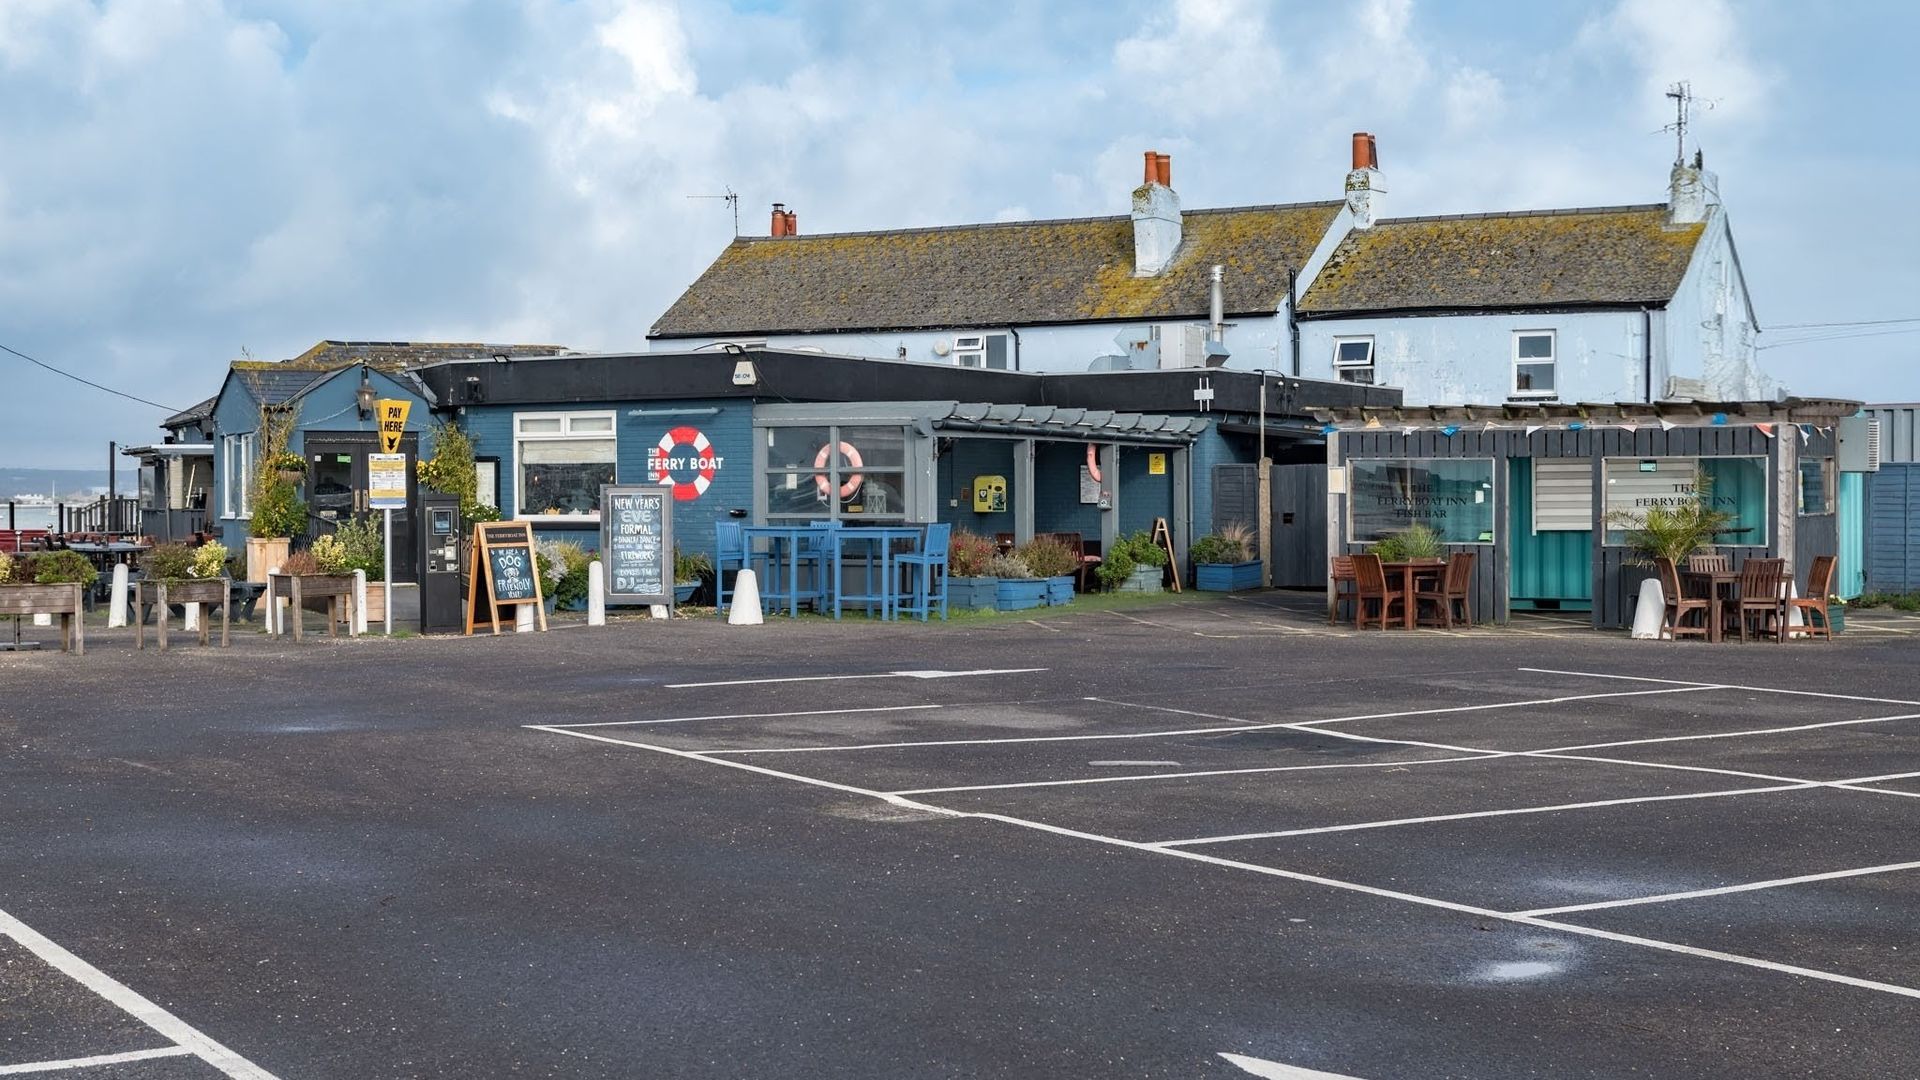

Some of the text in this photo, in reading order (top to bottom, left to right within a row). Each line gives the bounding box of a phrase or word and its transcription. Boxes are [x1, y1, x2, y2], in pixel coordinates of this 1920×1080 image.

[388, 407, 402, 418] PAY
[384, 421, 403, 432] HERE
[648, 448, 660, 456] THE
[647, 457, 724, 470] FERRY BOAT
[648, 472, 660, 480] INN
[1413, 484, 1433, 493] THE
[614, 497, 660, 510] NEW YEAR'S
[1378, 496, 1468, 506] FERRYBOAT INN
[1712, 496, 1736, 505] INN
[620, 510, 652, 522] EVE
[1396, 509, 1447, 518] FISH BAR
[620, 524, 653, 535] FORMAL
[620, 550, 655, 561] FIREWORKS
[498, 555, 522, 569] DOG
[497, 578, 531, 592] FRIENDLY
[616, 576, 635, 590] DJ
